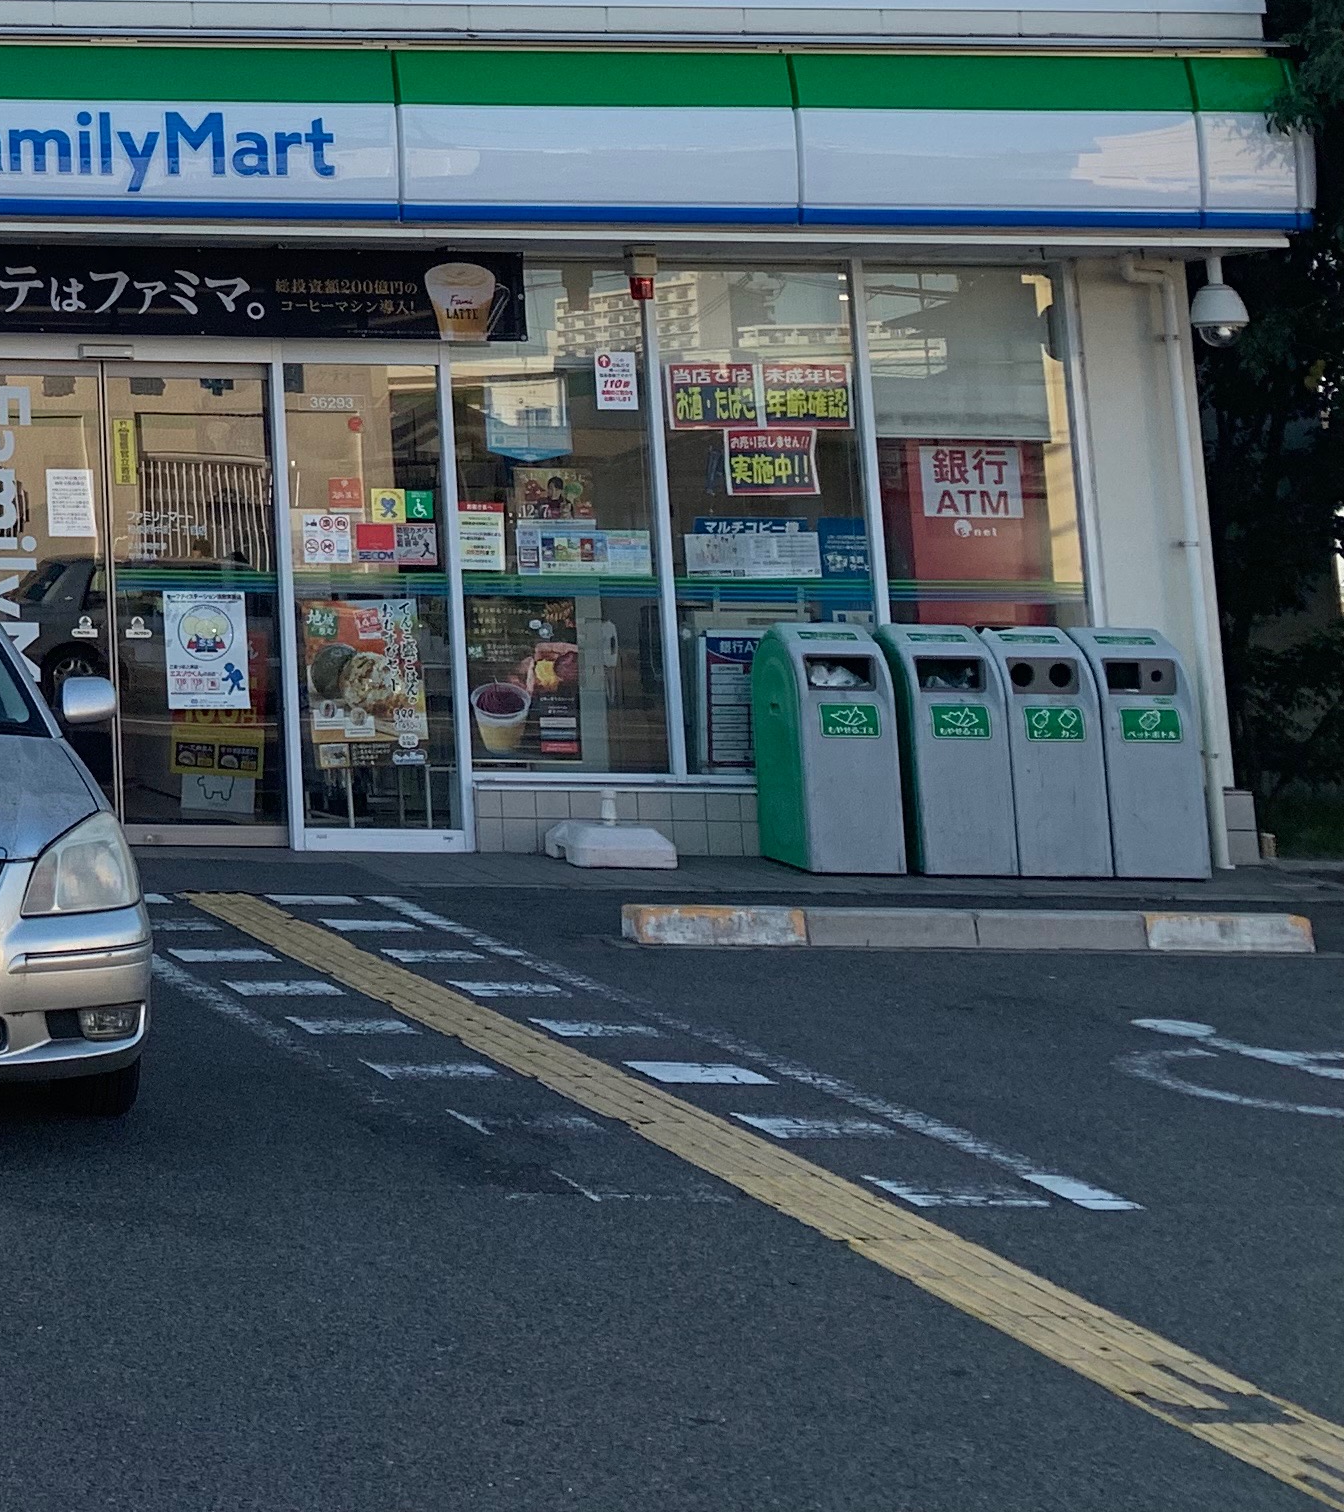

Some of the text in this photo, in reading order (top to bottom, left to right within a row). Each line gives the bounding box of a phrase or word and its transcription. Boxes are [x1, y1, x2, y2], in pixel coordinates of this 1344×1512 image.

[446, 308, 480, 320] LATTE
[673, 368, 752, 384] 当店では
[765, 369, 844, 384] 未成年に
[675, 386, 756, 421] お酒・たばこ
[766, 387, 848, 419] 年齢確認
[730, 453, 810, 485] 実施中!!
[932, 449, 1008, 485] 銀行
[936, 489, 1010, 516] ATM
[358, 551, 395, 560] SECOM
[827, 726, 874, 735] もやせるゴミ
[939, 727, 985, 736] もやせるゴミ
[1033, 730, 1078, 738] ビン カン
[1127, 730, 1176, 739] ペットボトル
